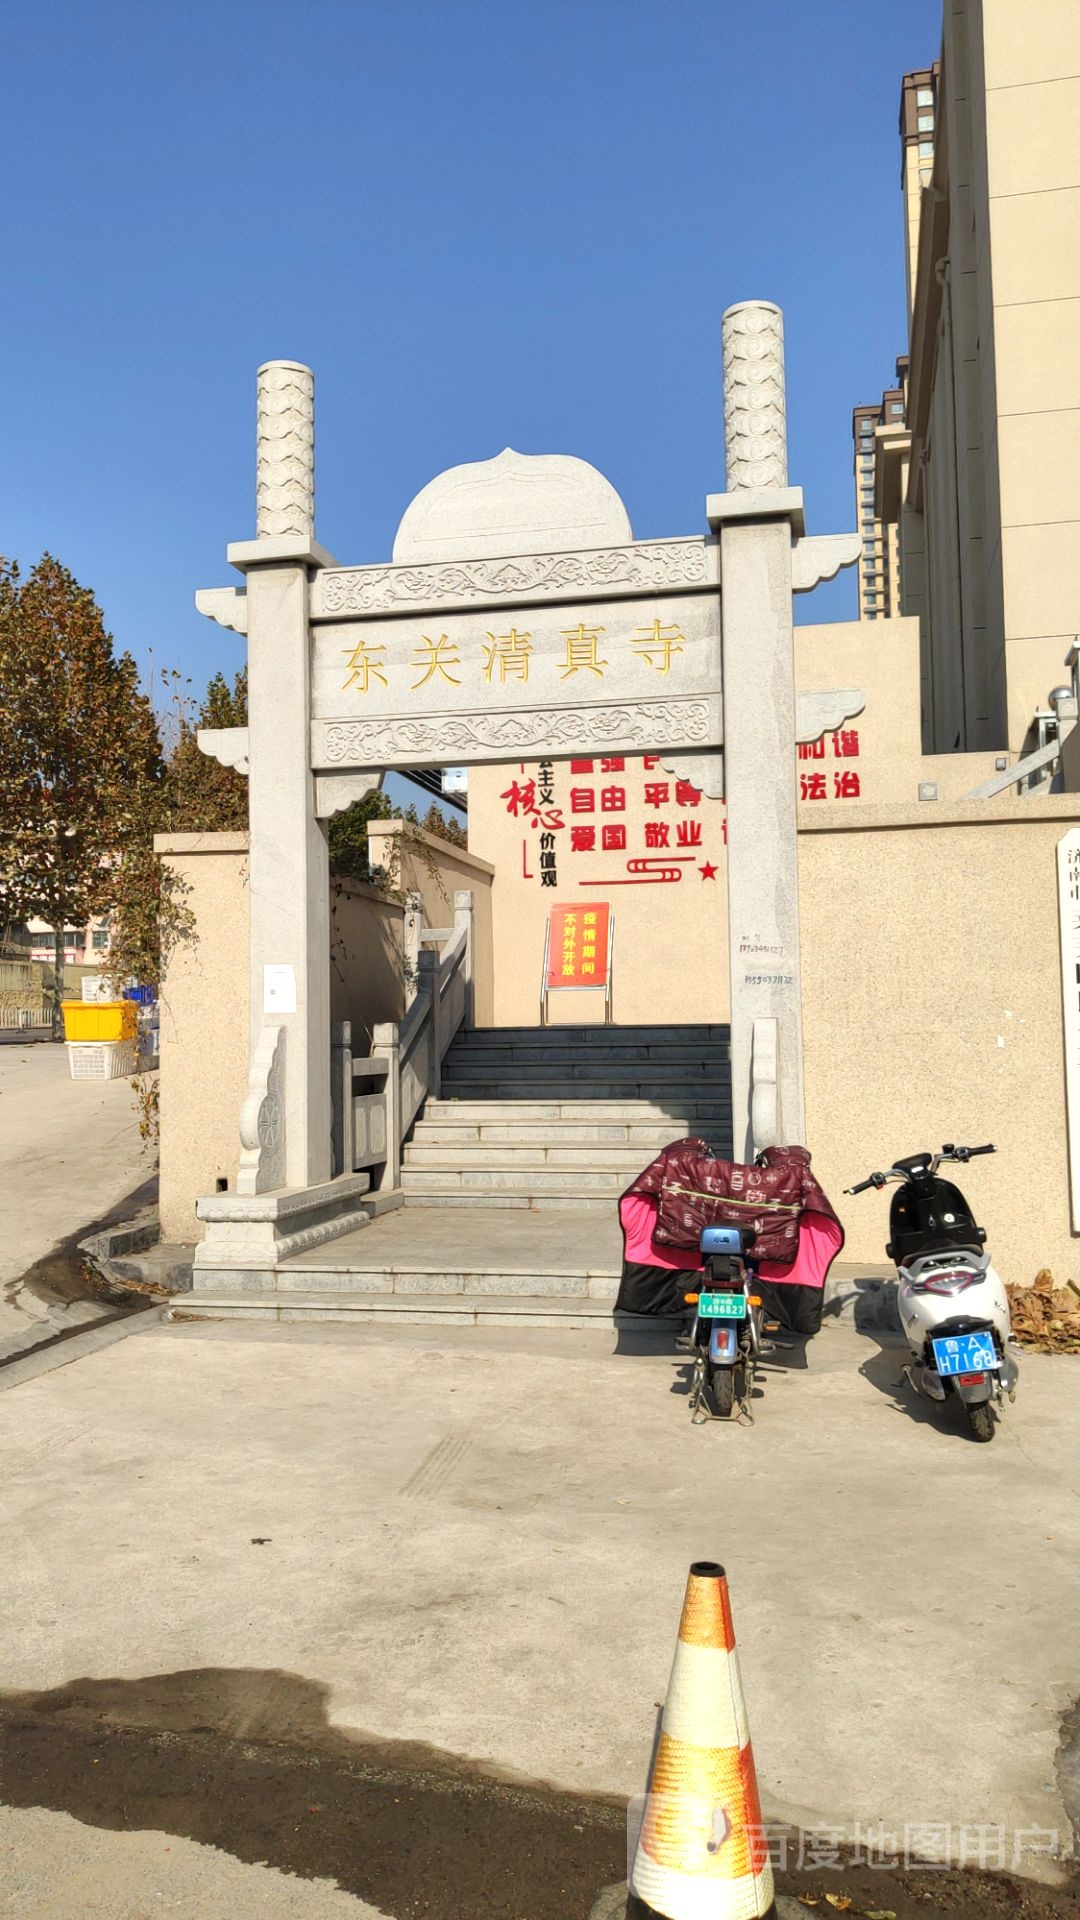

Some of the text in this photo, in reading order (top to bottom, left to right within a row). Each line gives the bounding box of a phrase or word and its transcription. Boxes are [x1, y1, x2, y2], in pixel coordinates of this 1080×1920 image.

[340, 618, 685, 694] 东关清真寺
[500, 778, 566, 831] 核心
[570, 785, 626, 814] 自由
[800, 771, 860, 801] 法治
[539, 832, 558, 887] 价值观
[570, 824, 626, 852] 爱国
[644, 820, 703, 850] 敬业
[561, 913, 577, 976] 不对外开放
[581, 912, 597, 976] 疫情期间
[702, 1303, 743, 1315] 1496827
[939, 1350, 993, 1373] H7168
